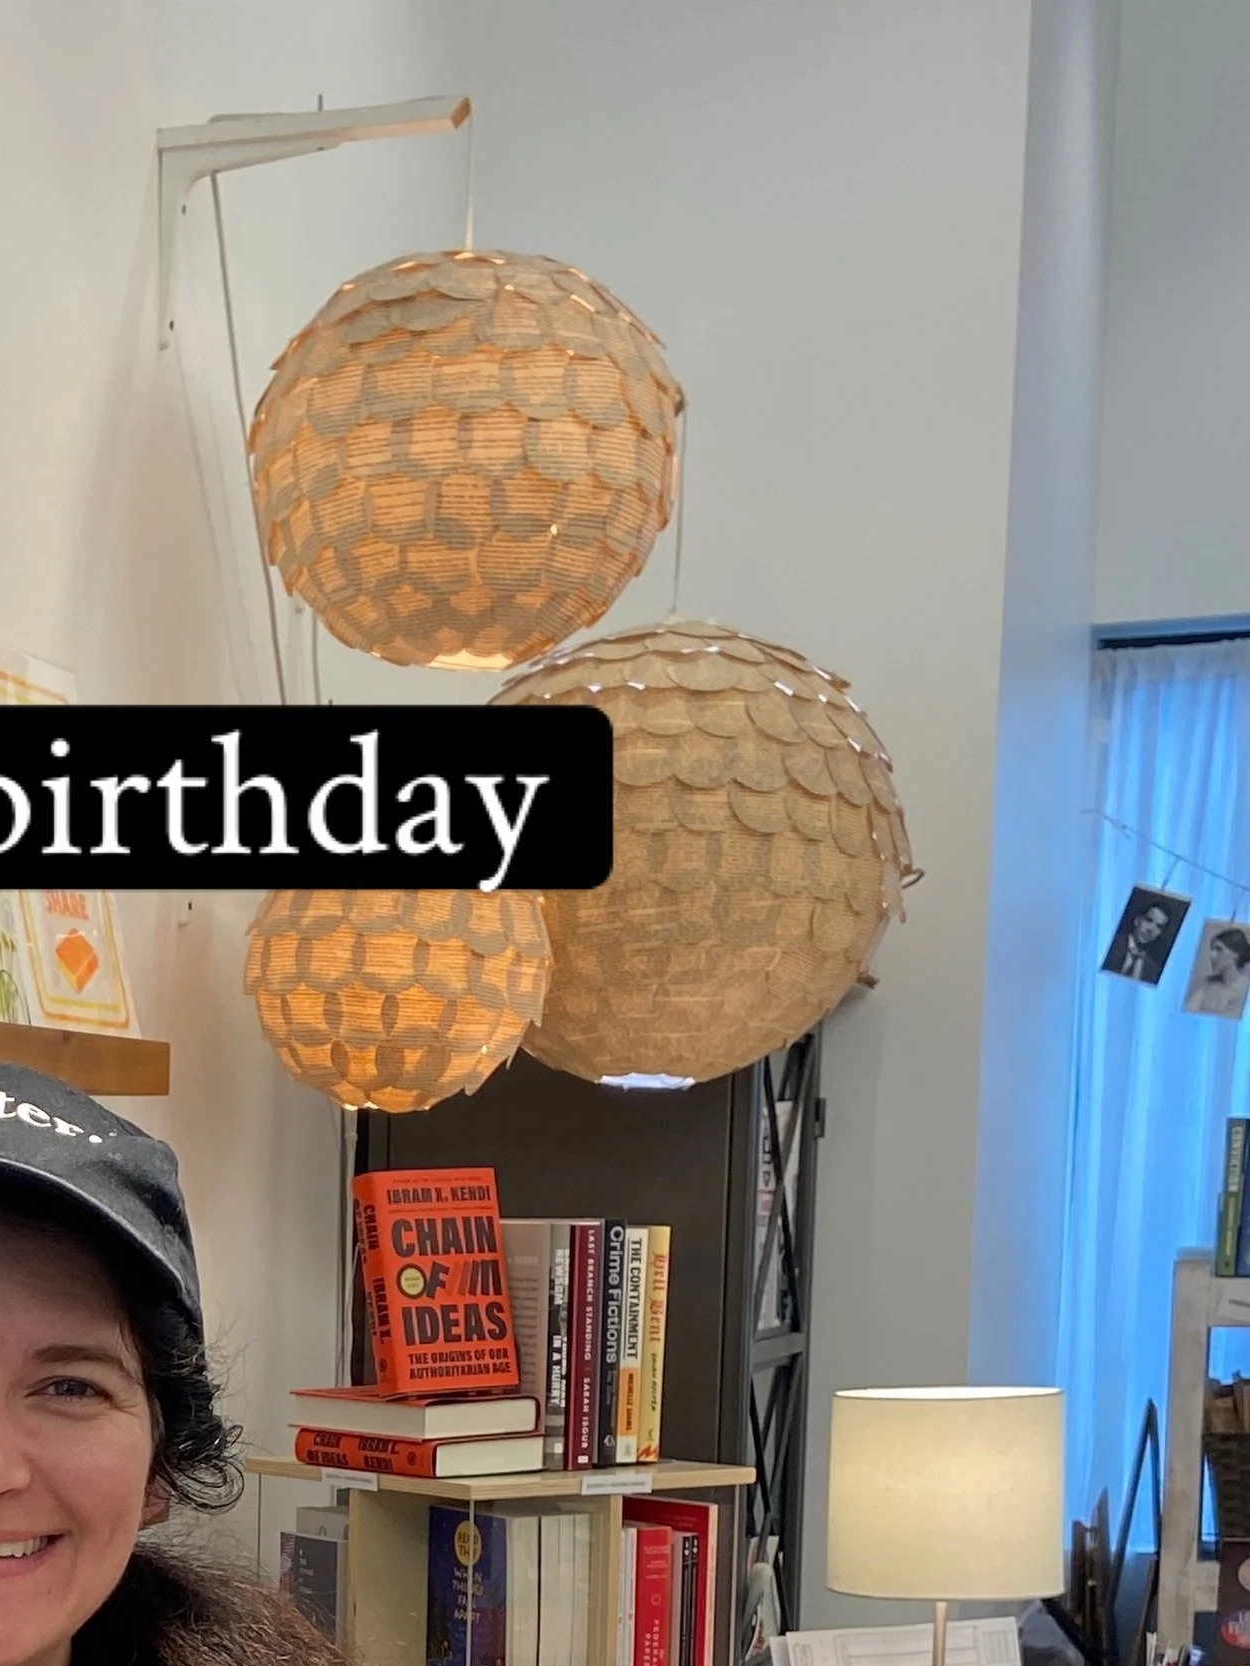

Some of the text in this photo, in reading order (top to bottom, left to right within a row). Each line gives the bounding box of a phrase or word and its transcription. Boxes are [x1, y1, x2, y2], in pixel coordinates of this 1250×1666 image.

[387, 1187, 432, 1205] IBRAM
[452, 1185, 490, 1201] KENDI
[390, 1216, 497, 1258] CHAIN
[630, 1239, 641, 1267] THE
[397, 1260, 450, 1299] OF
[606, 1226, 625, 1364] Crime Fictions
[401, 1301, 508, 1346] IDEAS
[627, 1269, 640, 1359] CONTAINMENT
[408, 1348, 509, 1365] THE ORIGINS OF OUR
[409, 1363, 511, 1380] AUTHORITARIAN AGE
